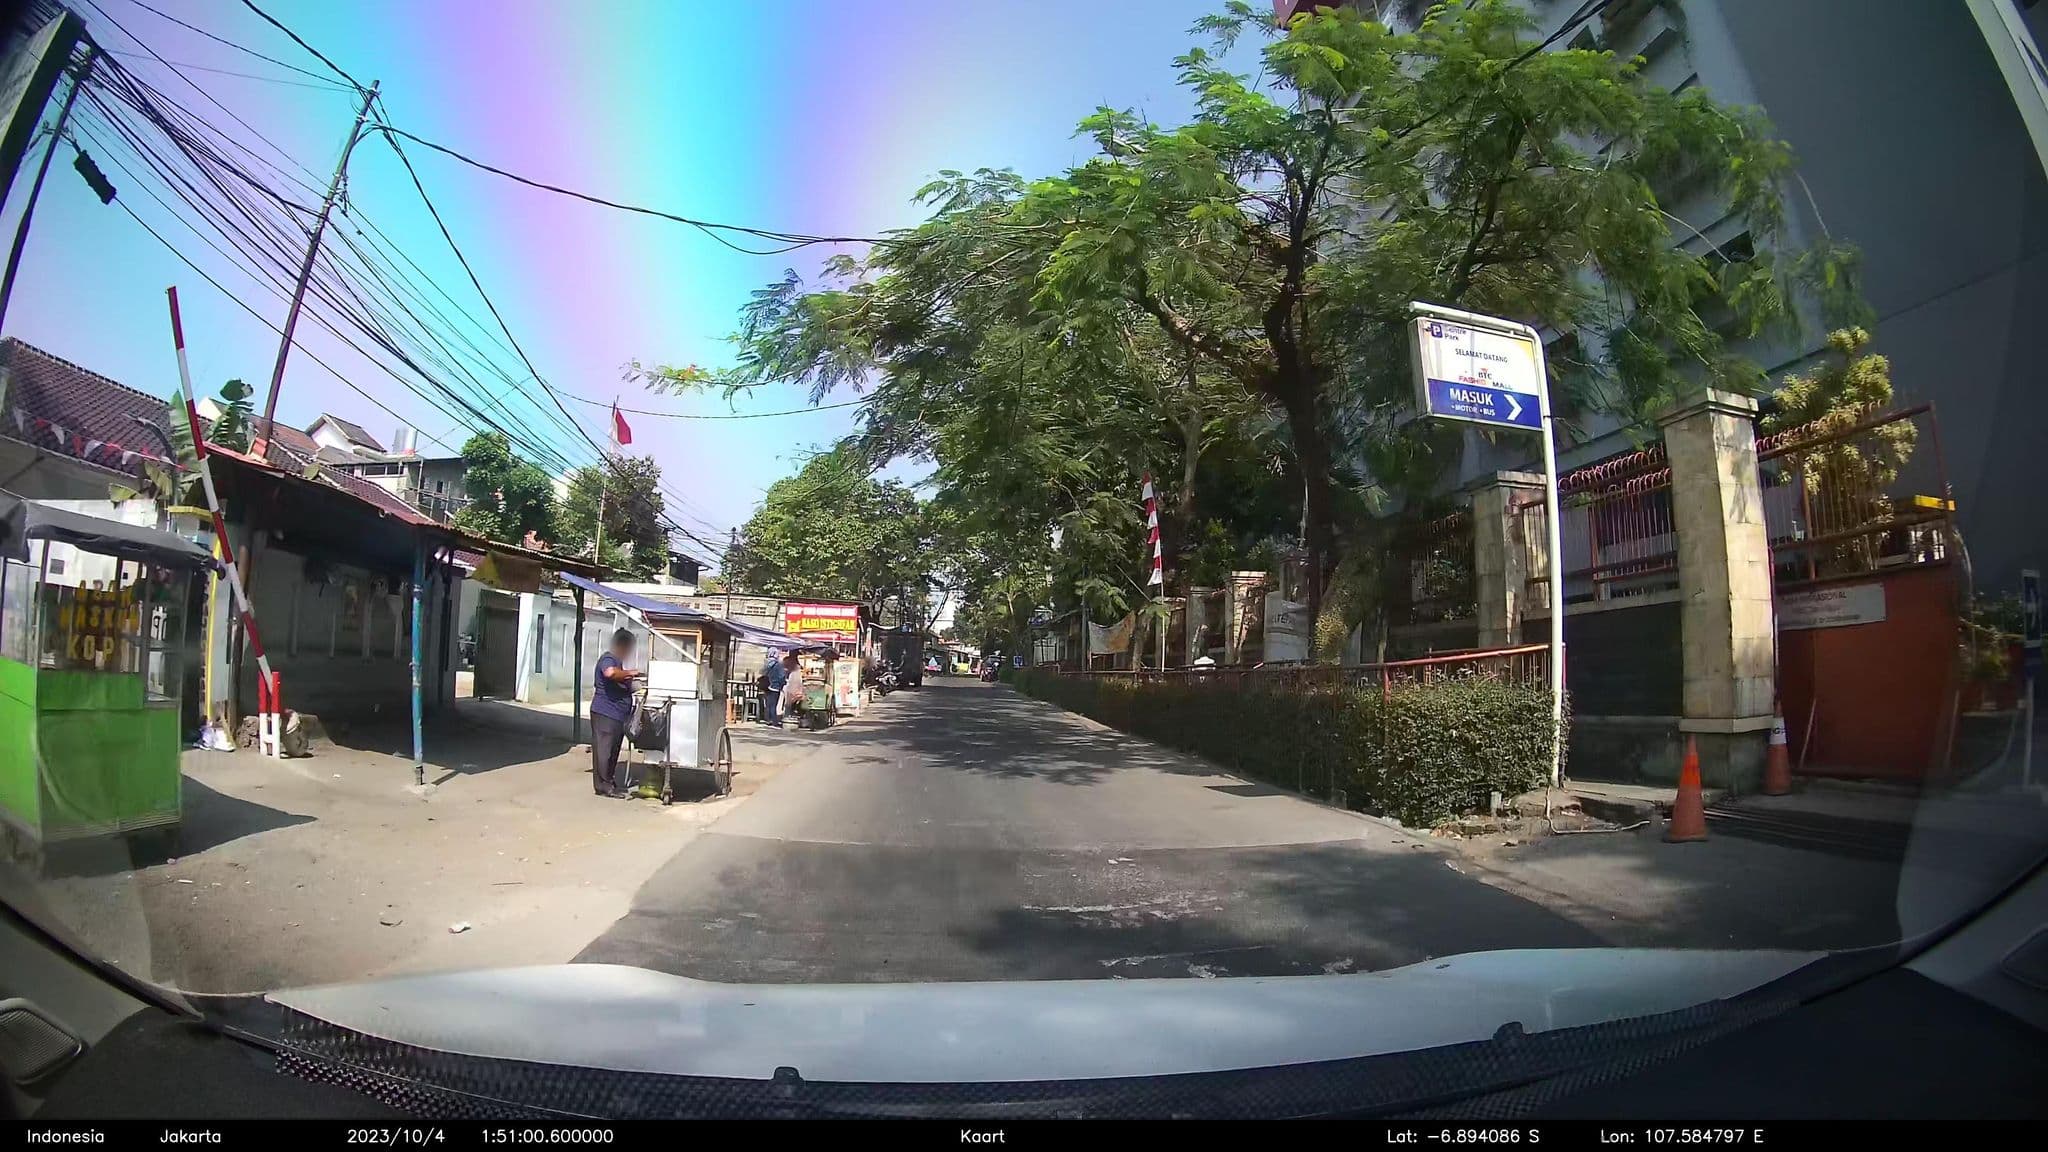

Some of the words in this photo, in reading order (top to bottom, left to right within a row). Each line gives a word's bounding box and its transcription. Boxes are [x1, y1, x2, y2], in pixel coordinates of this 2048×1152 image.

[1455, 348, 1483, 359] SELAMAT
[1483, 352, 1508, 363] DATANG
[1449, 387, 1494, 406] MASUK
[1455, 404, 1478, 414] MOTOR
[1483, 408, 1496, 417] BUS
